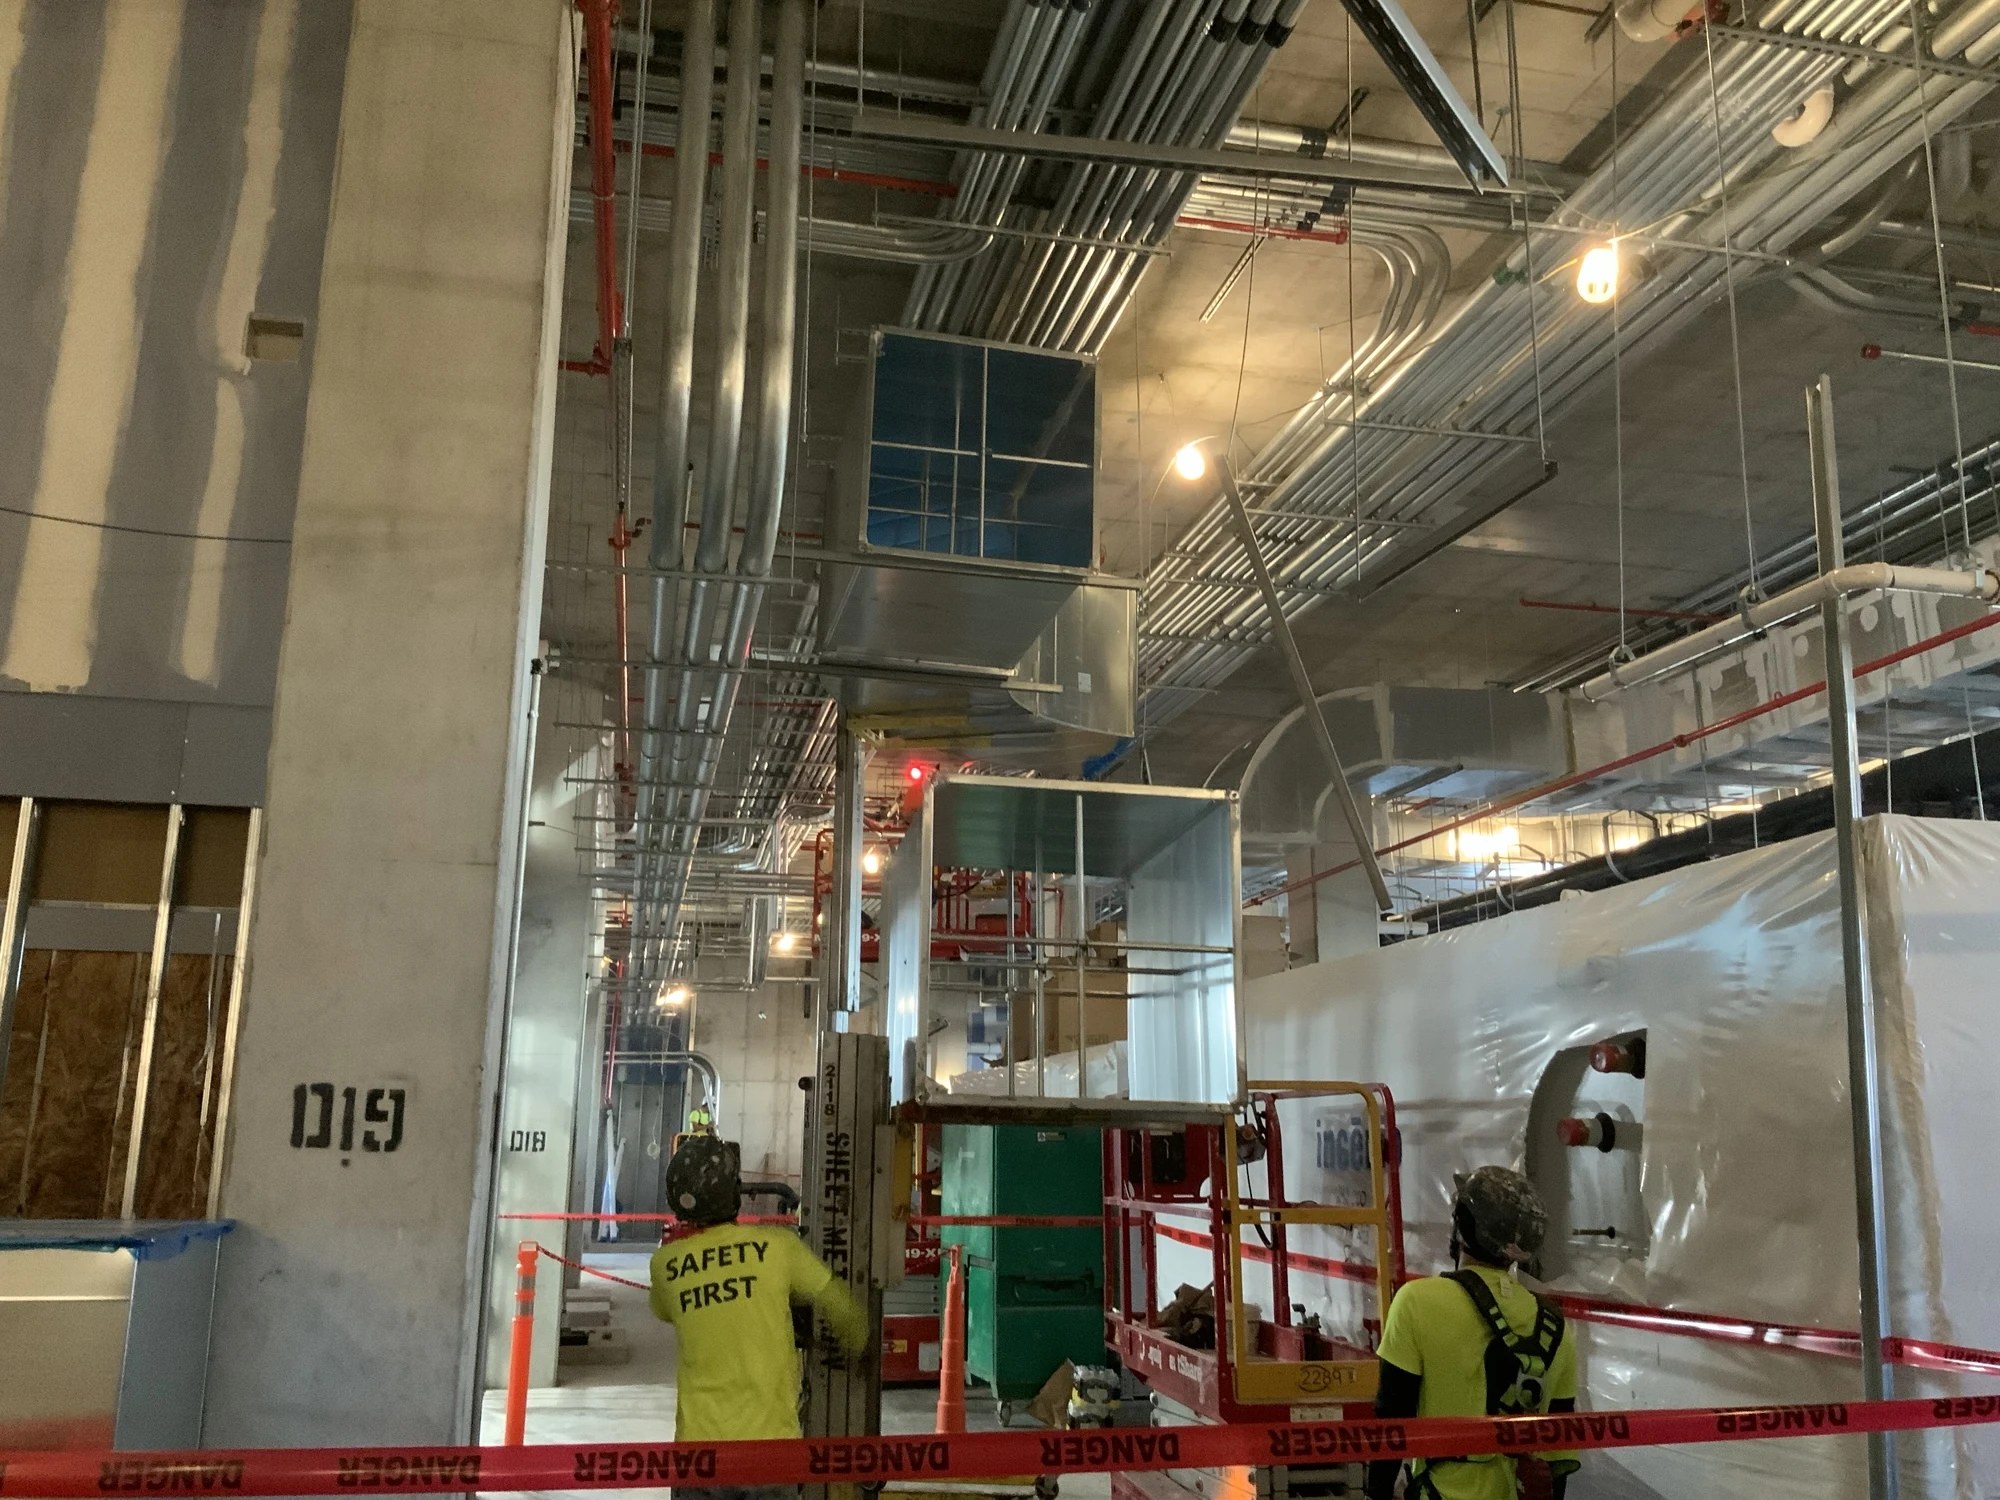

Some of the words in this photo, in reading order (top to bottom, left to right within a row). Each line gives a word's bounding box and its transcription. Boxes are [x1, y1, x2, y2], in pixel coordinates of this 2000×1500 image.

[824, 1065, 836, 1116] 2118
[666, 1241, 769, 1281] SAFETY
[680, 1276, 757, 1313] FIRST
[97, 1459, 246, 1491] DANGER
[336, 1454, 482, 1487] DANGER
[573, 1448, 717, 1482] DANGER
[807, 1440, 950, 1475] DANGER
[1040, 1433, 1181, 1467] DANGER
[1267, 1424, 1407, 1457] DANGER
[1495, 1415, 1631, 1446] DANGER
[1932, 1395, 2000, 1420] GER
